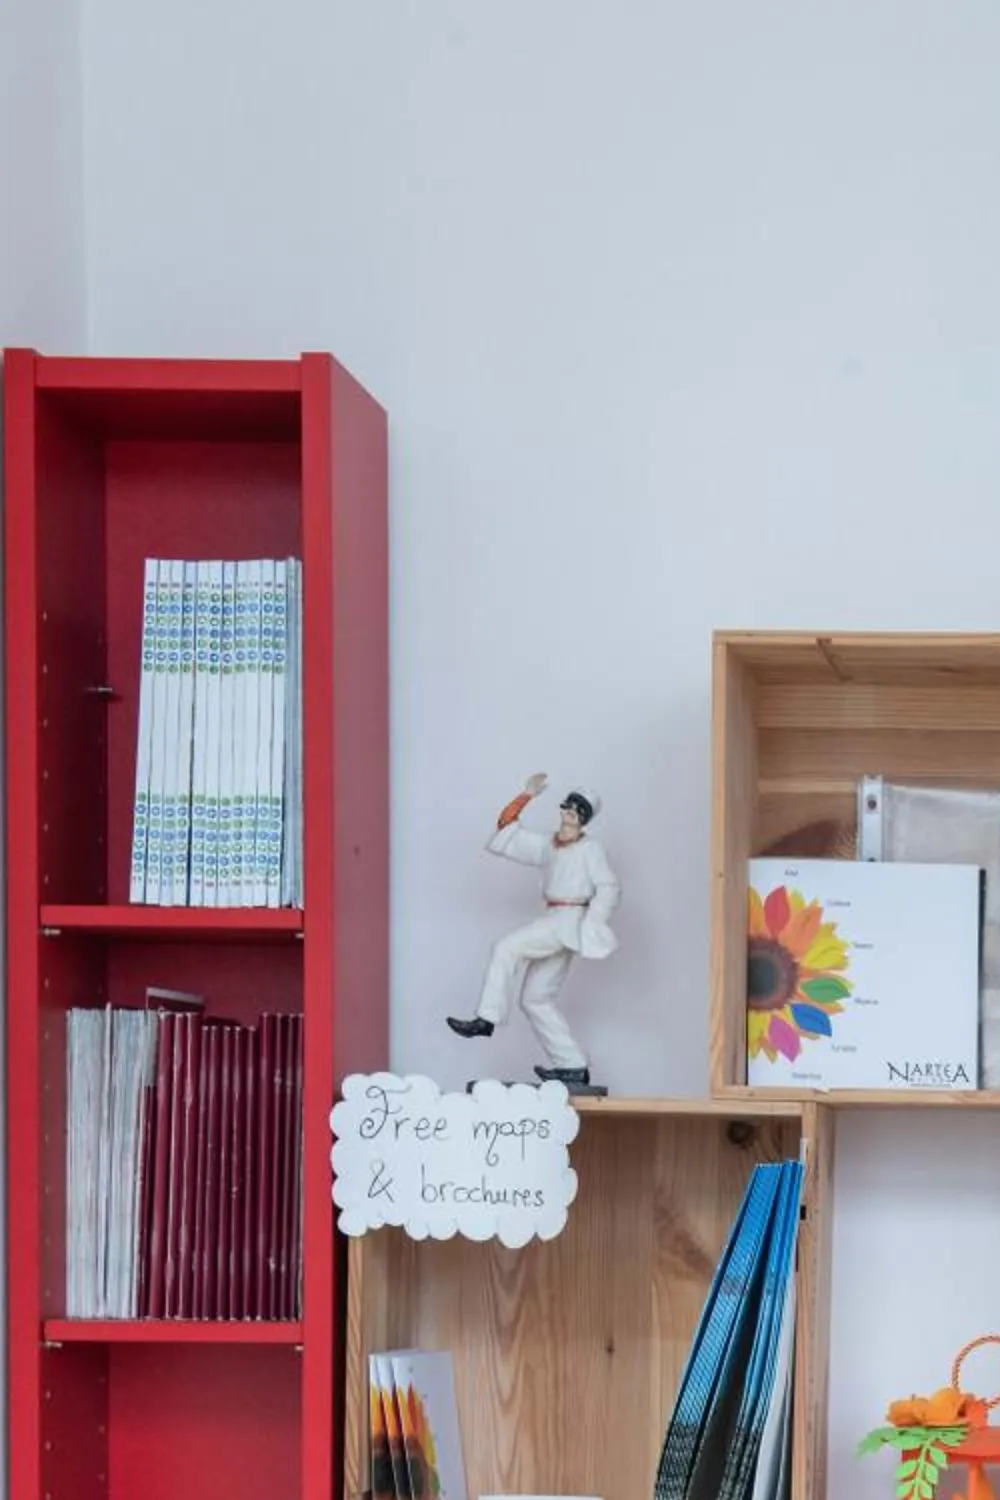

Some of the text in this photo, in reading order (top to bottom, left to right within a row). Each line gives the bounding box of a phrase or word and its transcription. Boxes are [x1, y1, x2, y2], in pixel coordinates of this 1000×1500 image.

[359, 1085, 552, 1167] Free maps
[367, 1158, 546, 1208] & brochures
